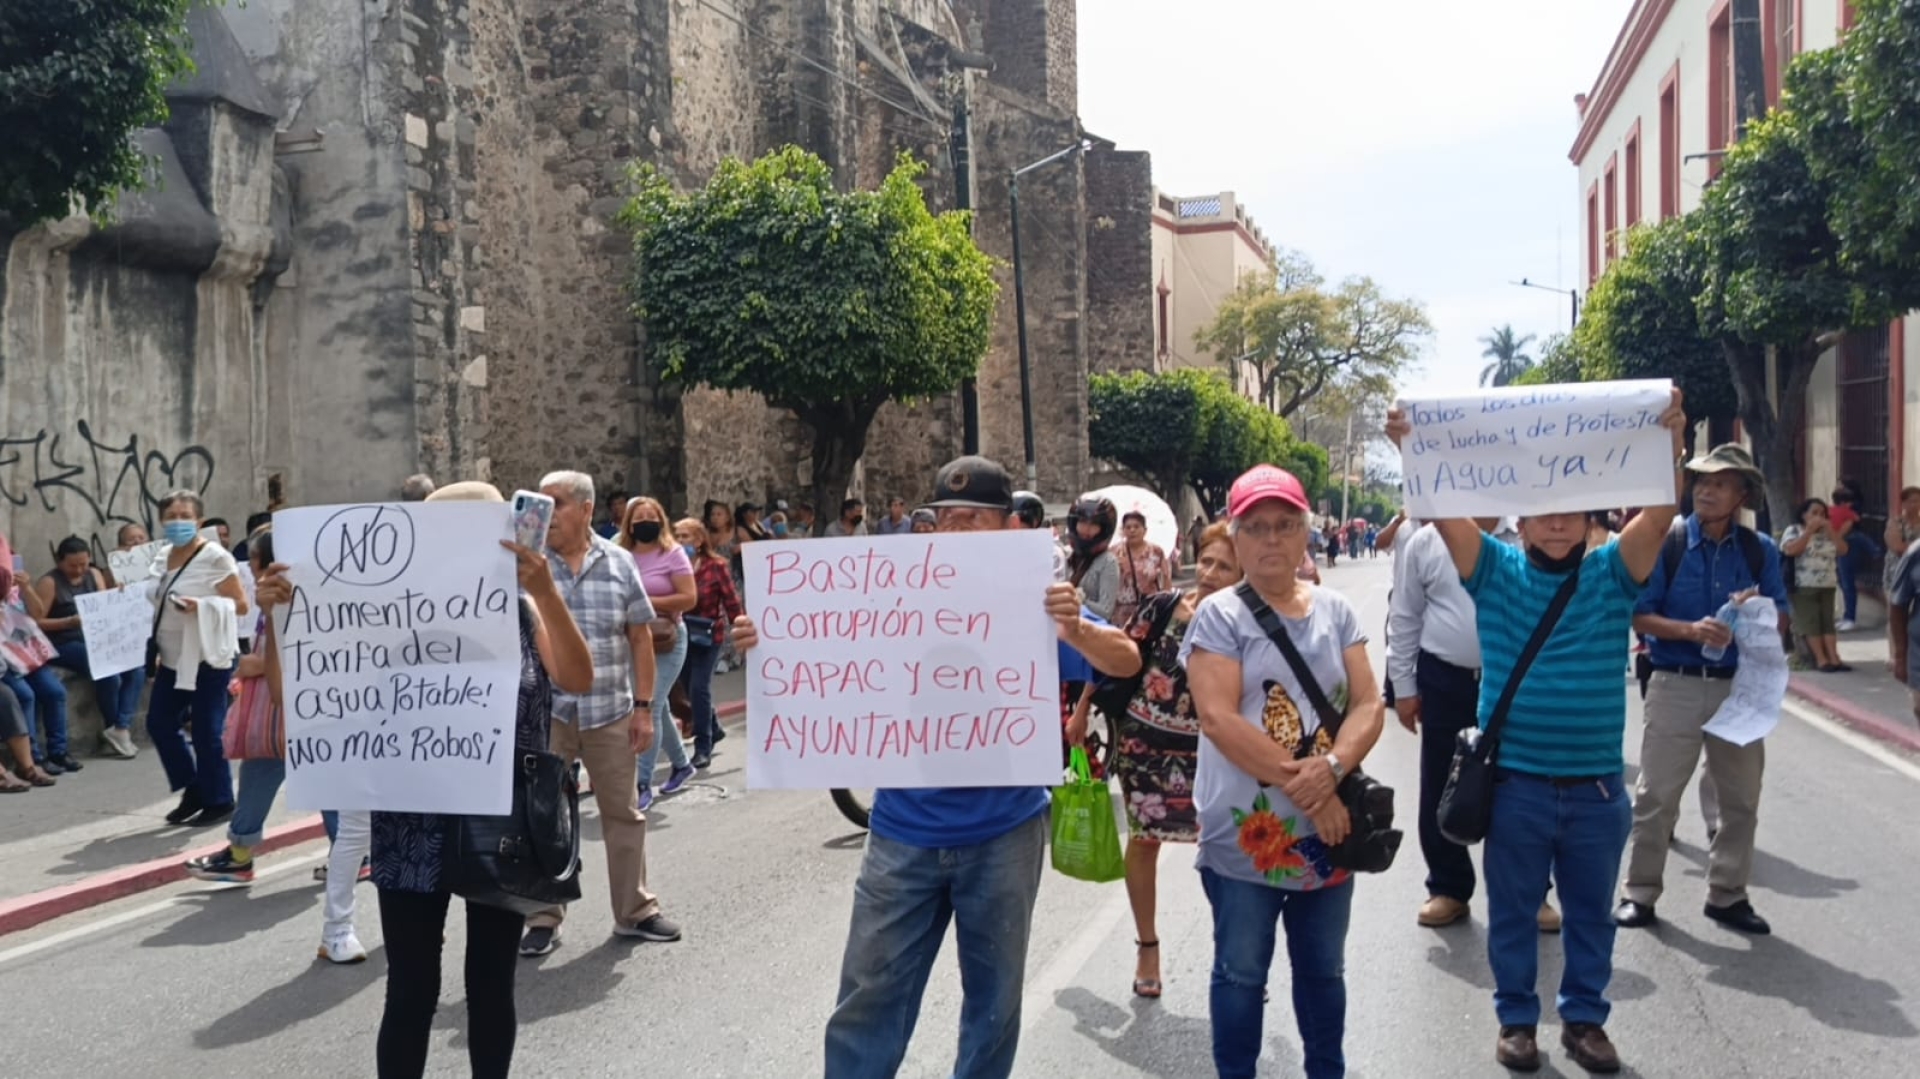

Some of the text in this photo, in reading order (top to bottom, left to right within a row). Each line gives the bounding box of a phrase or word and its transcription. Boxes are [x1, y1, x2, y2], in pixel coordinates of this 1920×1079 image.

[1405, 400, 1466, 427] Todos
[1411, 431, 1441, 456] de
[1527, 415, 1557, 438] de
[1565, 408, 1661, 437] Protesta
[338, 520, 399, 574] NO
[765, 542, 957, 596] Basta de
[282, 584, 435, 635] Aumento
[761, 596, 990, 642] Corrupión en
[282, 629, 462, 683] Tarifa del
[761, 657, 886, 700] SAPAC
[933, 664, 985, 694] en
[294, 672, 493, 720] agua Potable!
[341, 719, 402, 763] más
[763, 706, 1036, 760] AYUNTAMIENTO
